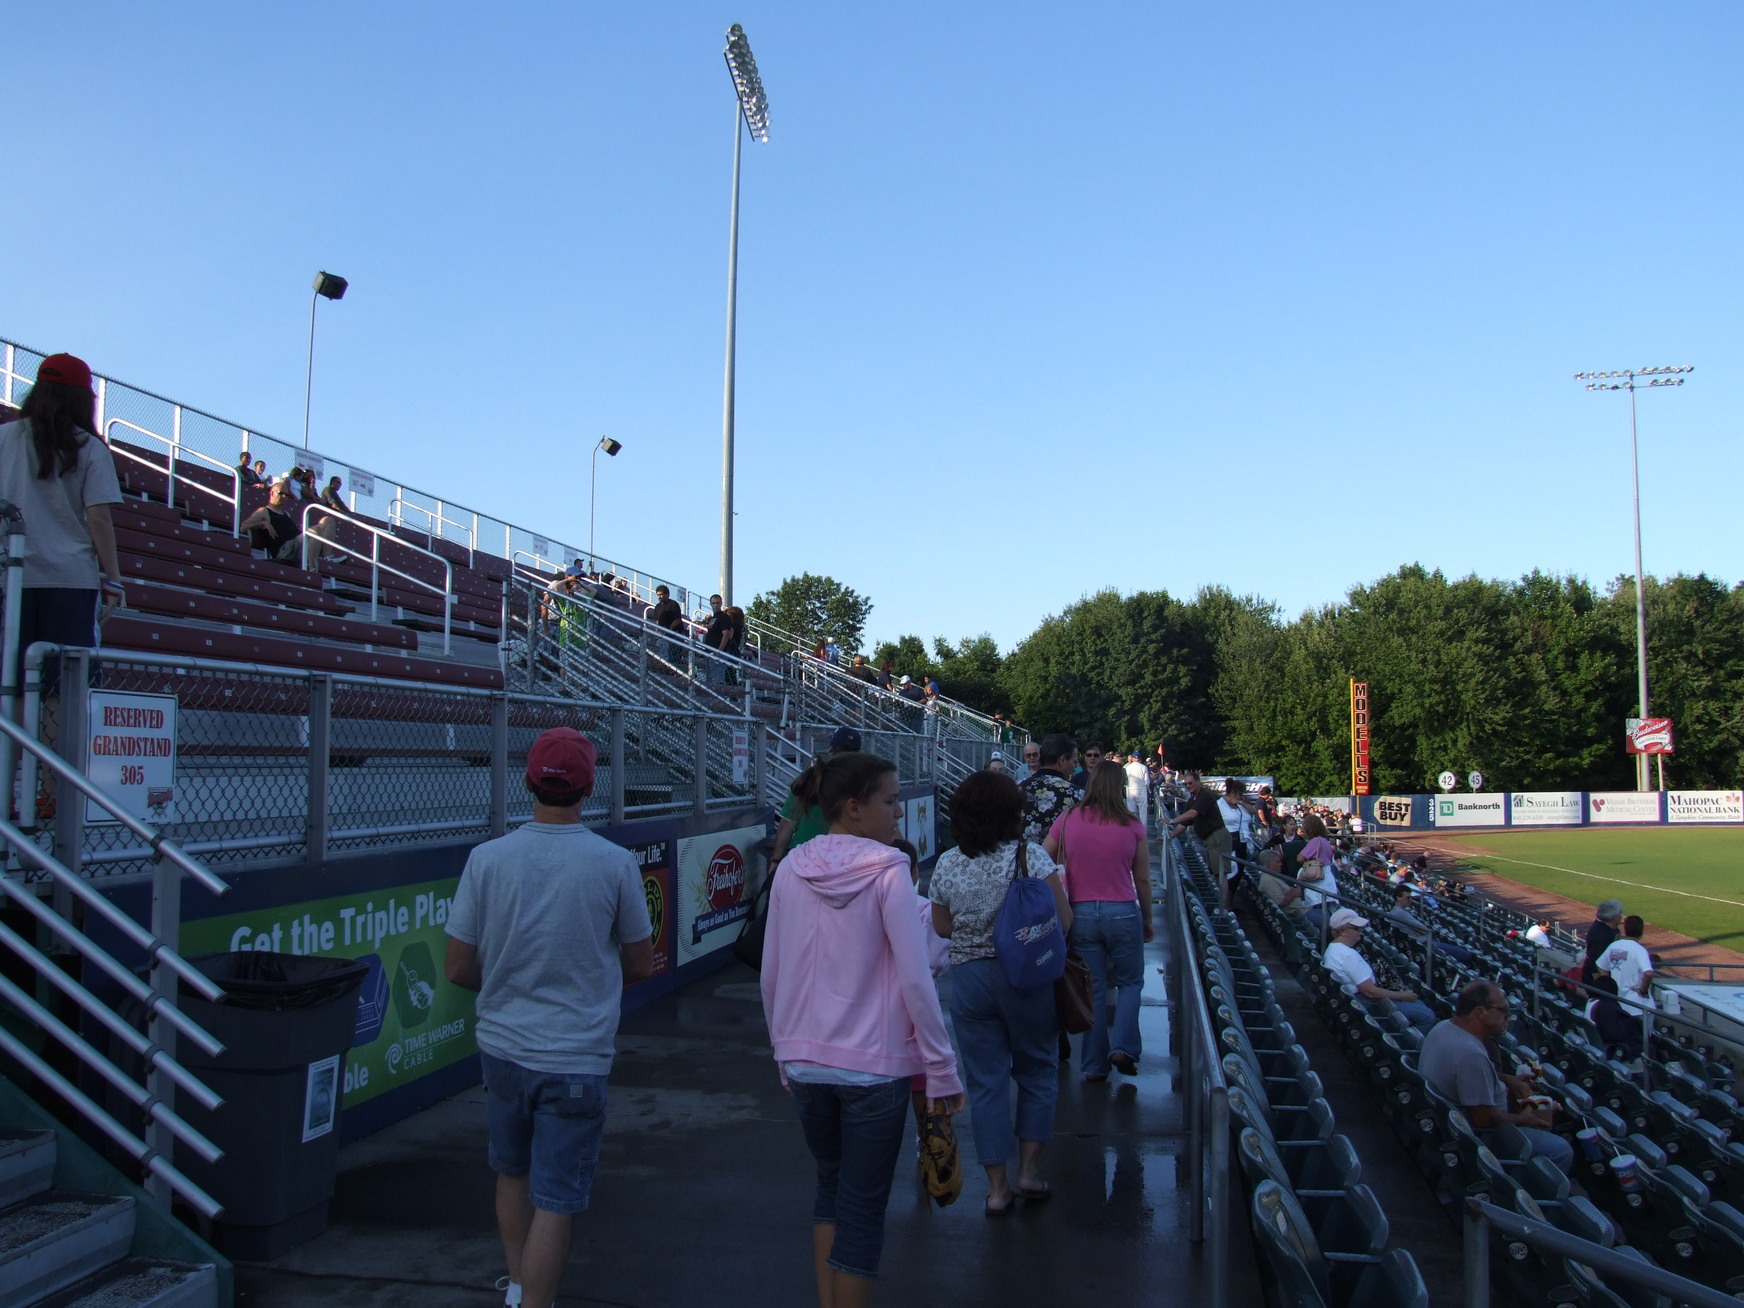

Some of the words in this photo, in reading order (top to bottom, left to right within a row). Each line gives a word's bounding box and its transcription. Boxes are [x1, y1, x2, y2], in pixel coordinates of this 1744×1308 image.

[103, 706, 164, 729] RESERVED
[93, 735, 172, 757] GRANDSTAND
[120, 765, 145, 785] 305
[1441, 776, 1453, 786] 42
[1471, 774, 1480, 785] 45
[1378, 801, 1411, 812] BEST
[1457, 803, 1501, 811] Banknorth
[1526, 796, 1559, 808] SAYEGH
[1560, 796, 1580, 808] LAW
[1670, 795, 1723, 806] MAHOPAC
[1379, 811, 1408, 821] BUY
[707, 857, 744, 901] Freihofer's
[230, 921, 284, 954] Get
[290, 913, 335, 956] the
[340, 899, 410, 951] Triple
[403, 1033, 428, 1052] TIME
[428, 1018, 465, 1043] WARNER
[403, 1048, 434, 1071] CABLE
